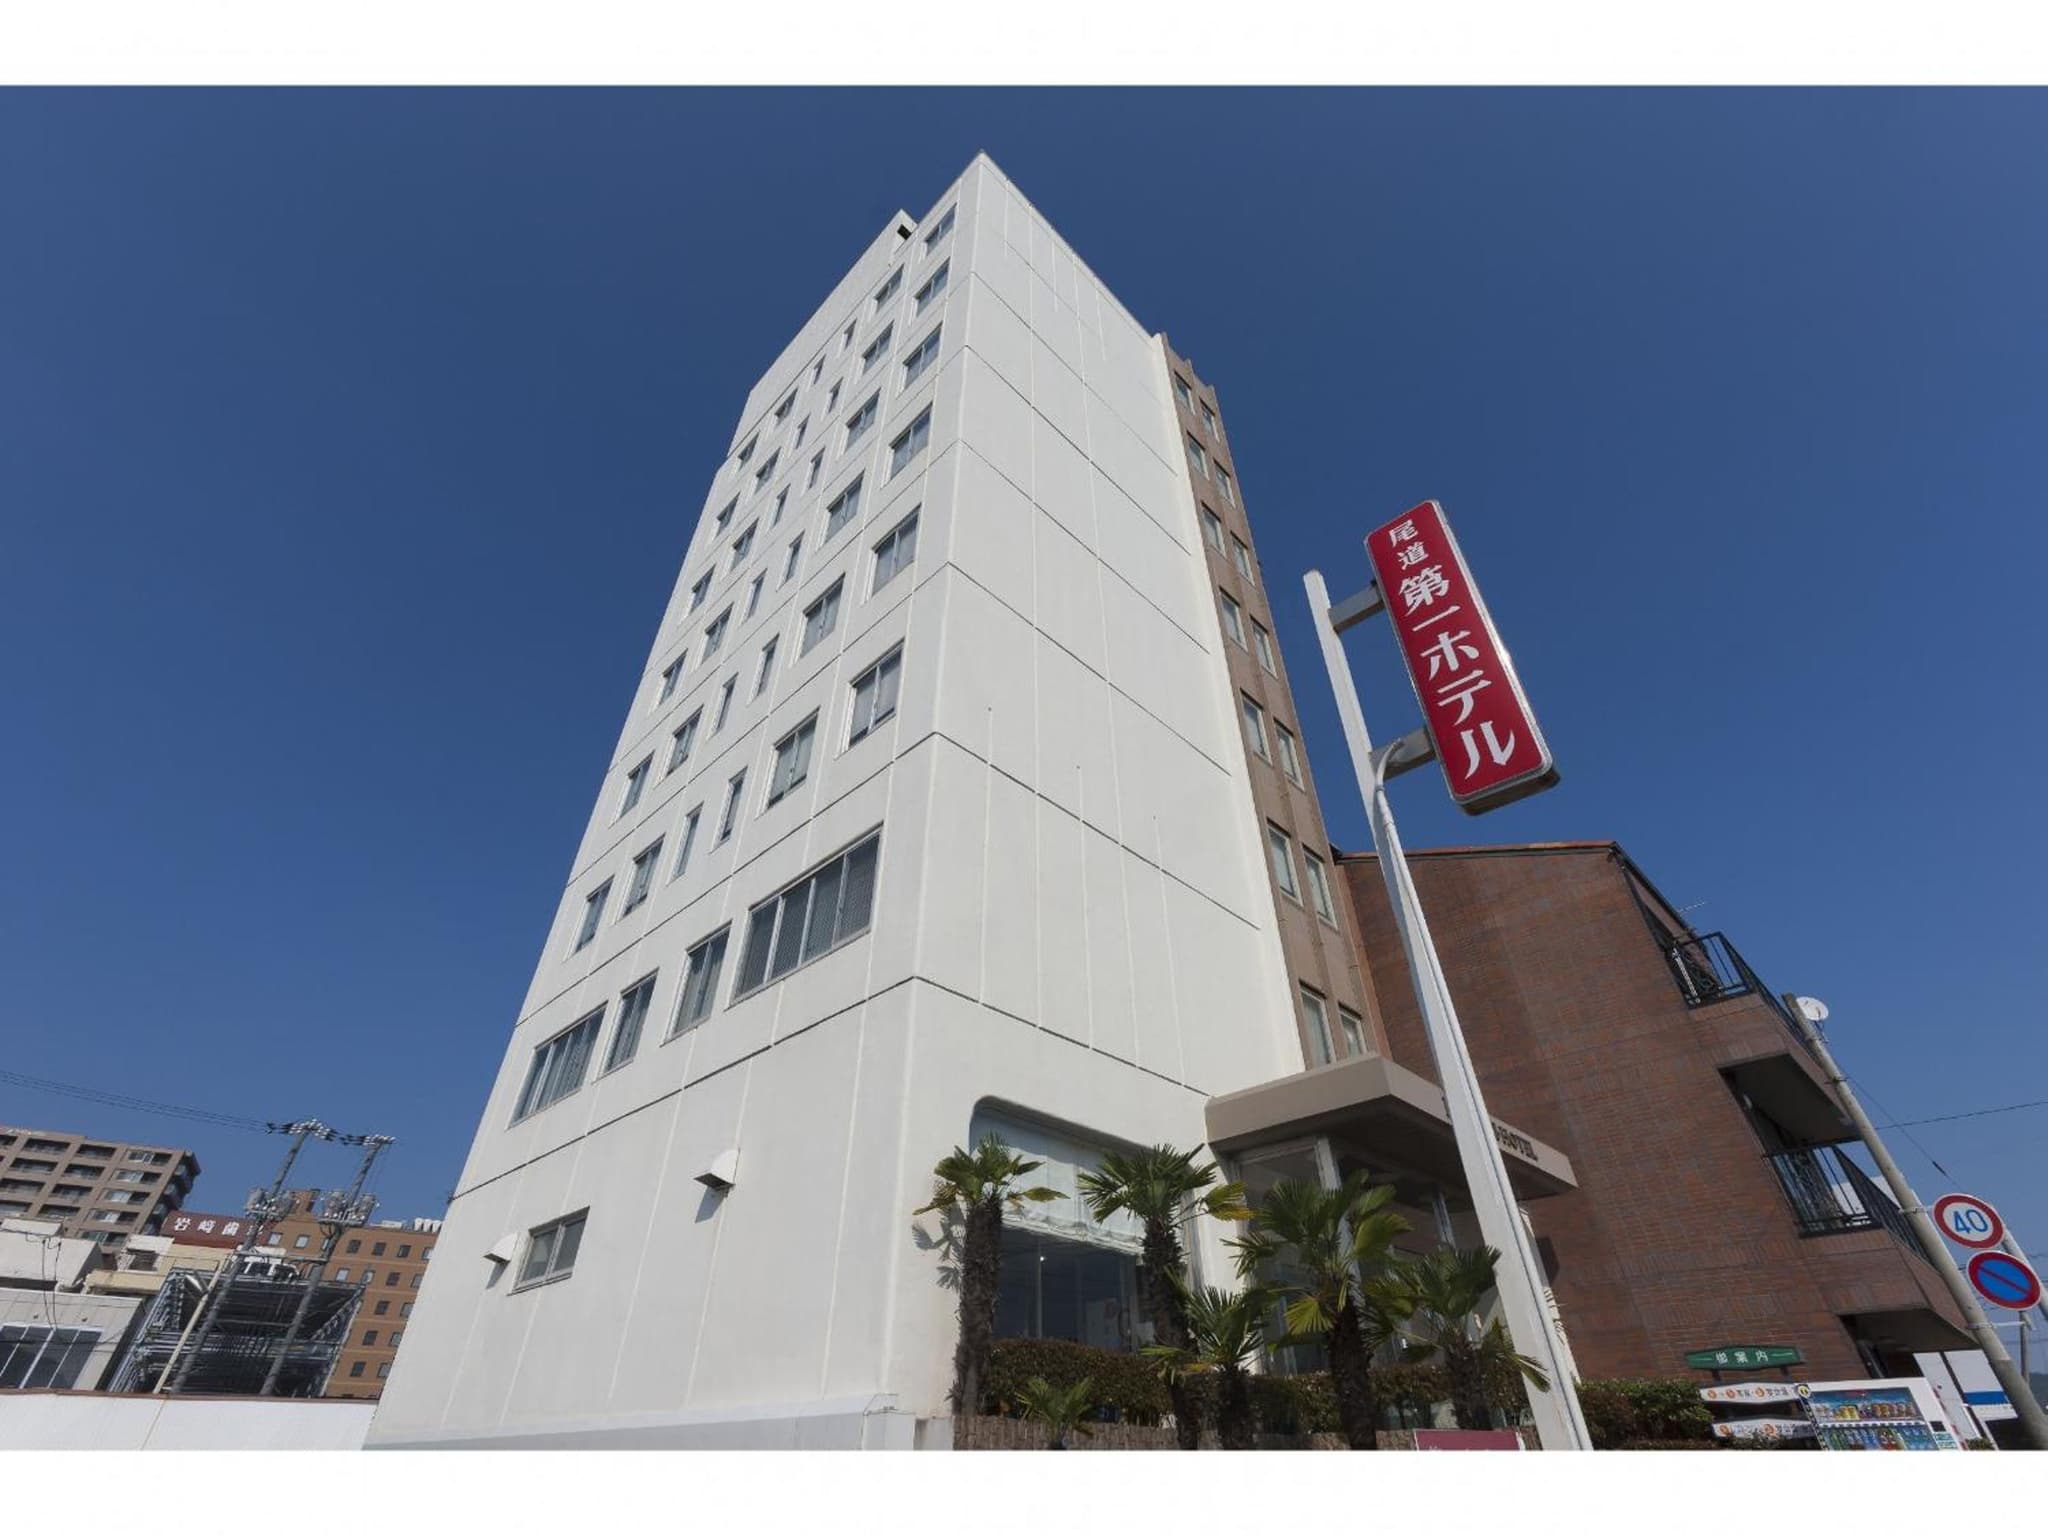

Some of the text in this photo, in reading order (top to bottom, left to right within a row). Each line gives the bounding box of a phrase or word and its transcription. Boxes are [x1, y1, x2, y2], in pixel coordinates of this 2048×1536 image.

[1389, 519, 1515, 780] 尾道第一ホテル
[1953, 1209, 1989, 1234] 40
